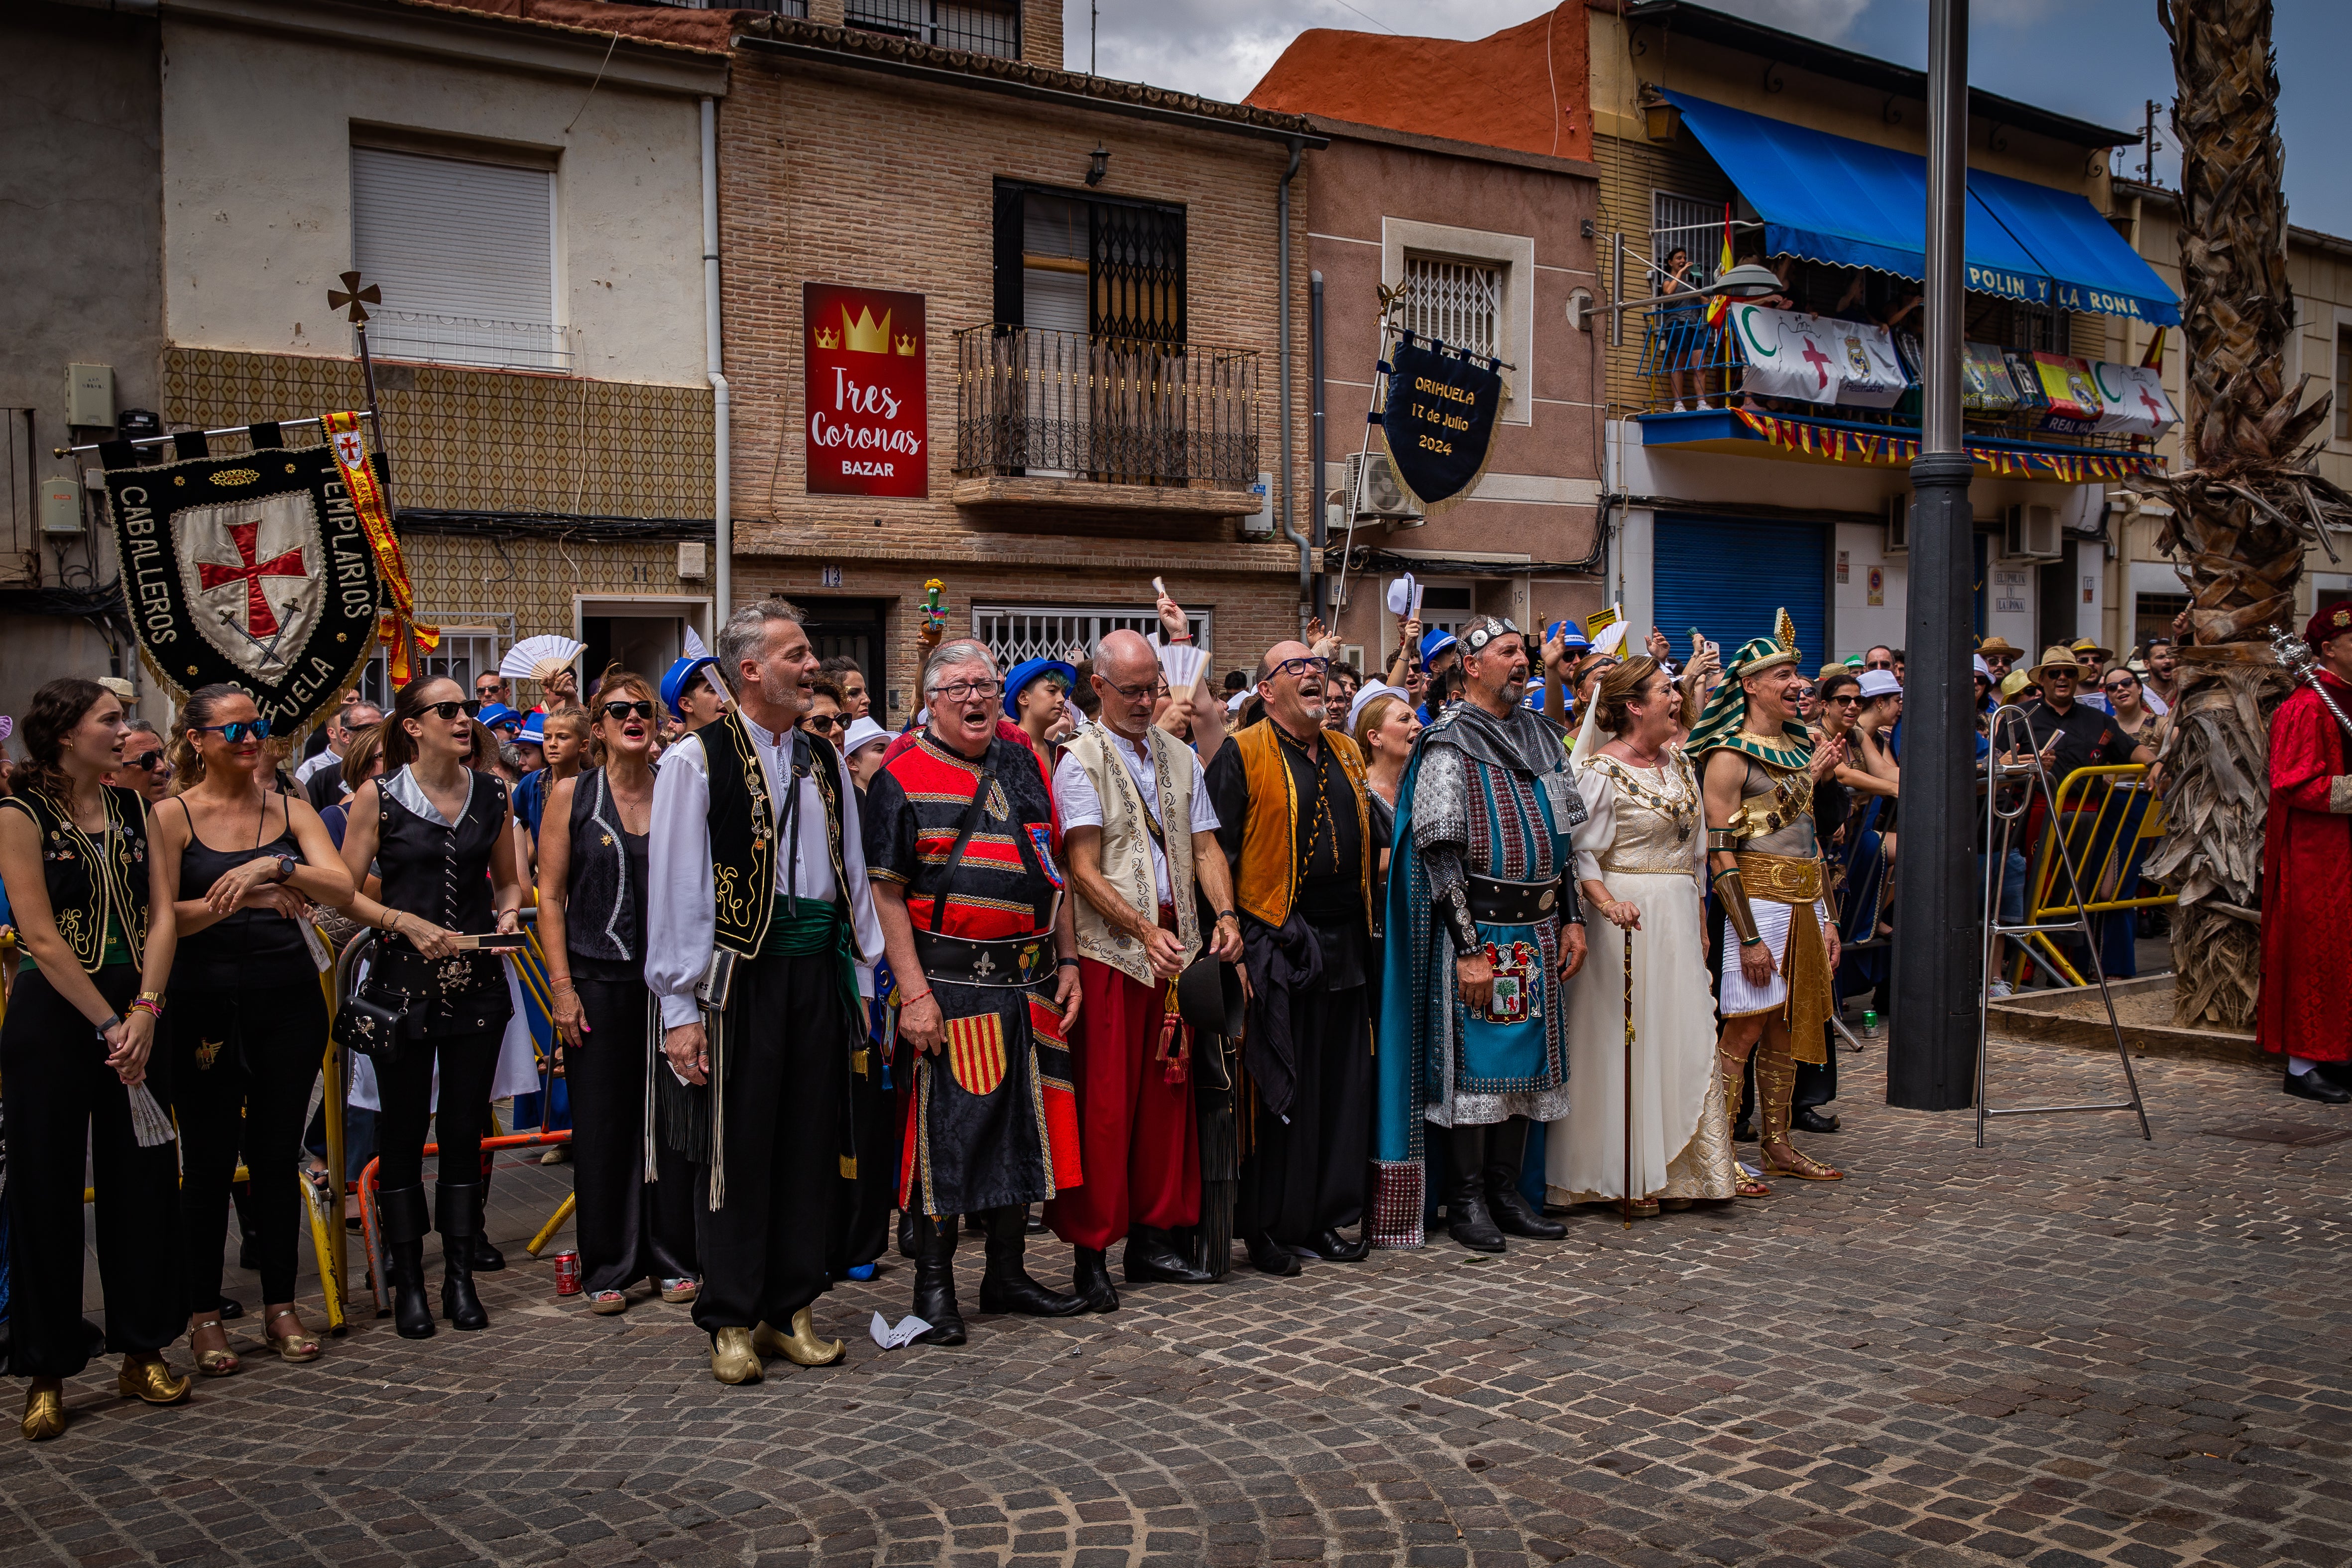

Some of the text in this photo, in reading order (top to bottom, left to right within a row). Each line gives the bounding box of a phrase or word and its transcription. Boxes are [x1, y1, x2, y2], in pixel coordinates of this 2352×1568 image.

[1969, 267, 2025, 296] POLIN
[2037, 280, 2047, 298] Y
[2059, 287, 2080, 307] LA
[831, 366, 902, 419] Tres
[1415, 376, 1475, 405] ORIHUELA
[1411, 403, 1469, 432] 17 de Julio
[2049, 417, 2075, 433] REAL
[812, 411, 922, 455] Coronas
[1419, 435, 1452, 456] 2024
[842, 460, 894, 477] BAZAR
[353, 475, 383, 543] ABANDERADA
[120, 486, 177, 644] CABALLEROS
[633, 566, 648, 582] 11
[824, 568, 840, 583] 13
[1514, 591, 1523, 604] 15
